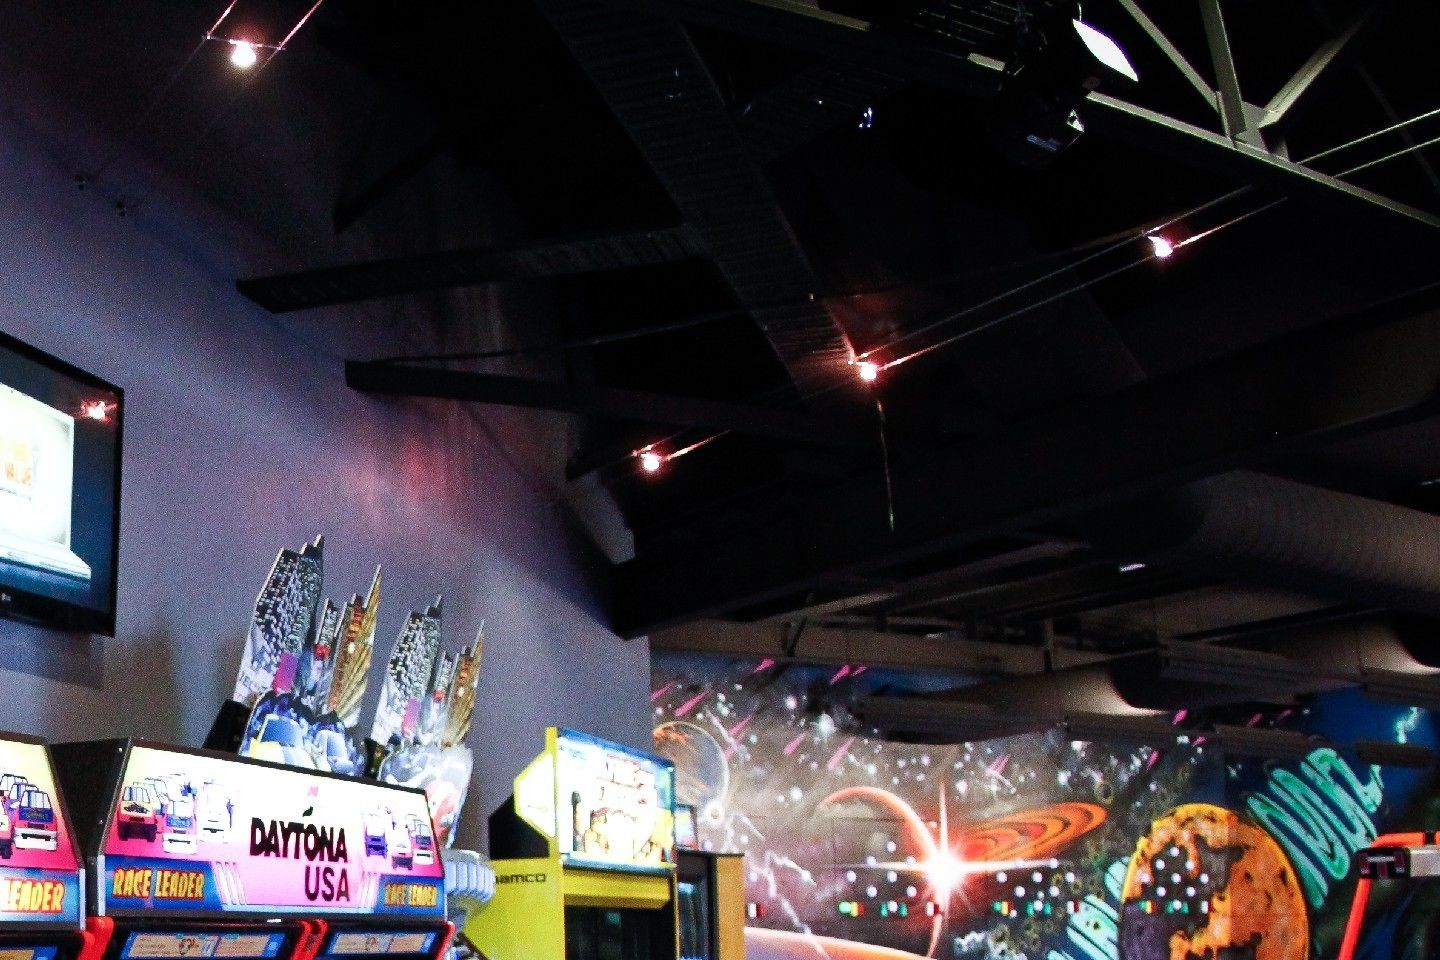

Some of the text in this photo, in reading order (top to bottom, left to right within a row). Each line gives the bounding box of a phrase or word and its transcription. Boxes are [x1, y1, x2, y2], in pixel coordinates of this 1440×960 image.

[249, 816, 348, 863] DAYTONA
[112, 867, 205, 900] RACE LEADER
[303, 866, 350, 902] USA
